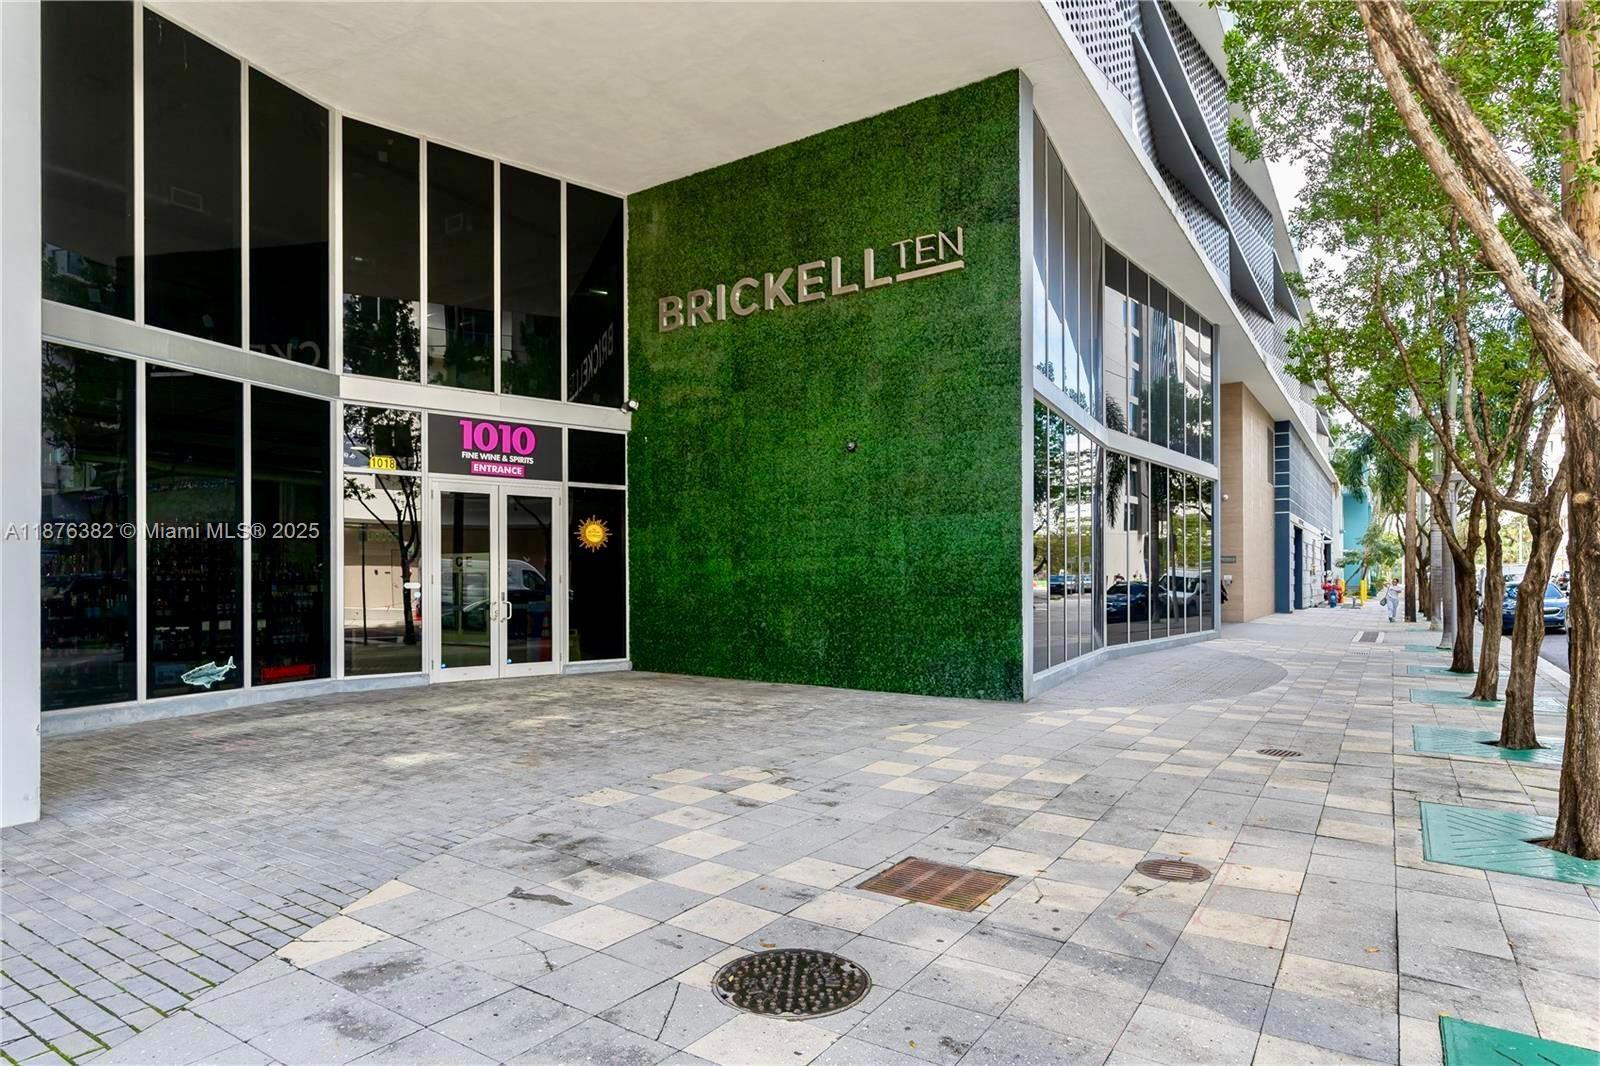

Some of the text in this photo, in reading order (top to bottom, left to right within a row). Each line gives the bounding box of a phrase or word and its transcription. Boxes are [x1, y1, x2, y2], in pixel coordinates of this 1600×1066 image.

[658, 226, 964, 333] BRICKELL TEN
[459, 419, 536, 455] 1010
[371, 457, 396, 469] 1018
[461, 451, 535, 465] FINE WINE & SPIRITS
[473, 463, 522, 475] ENTRANCE
